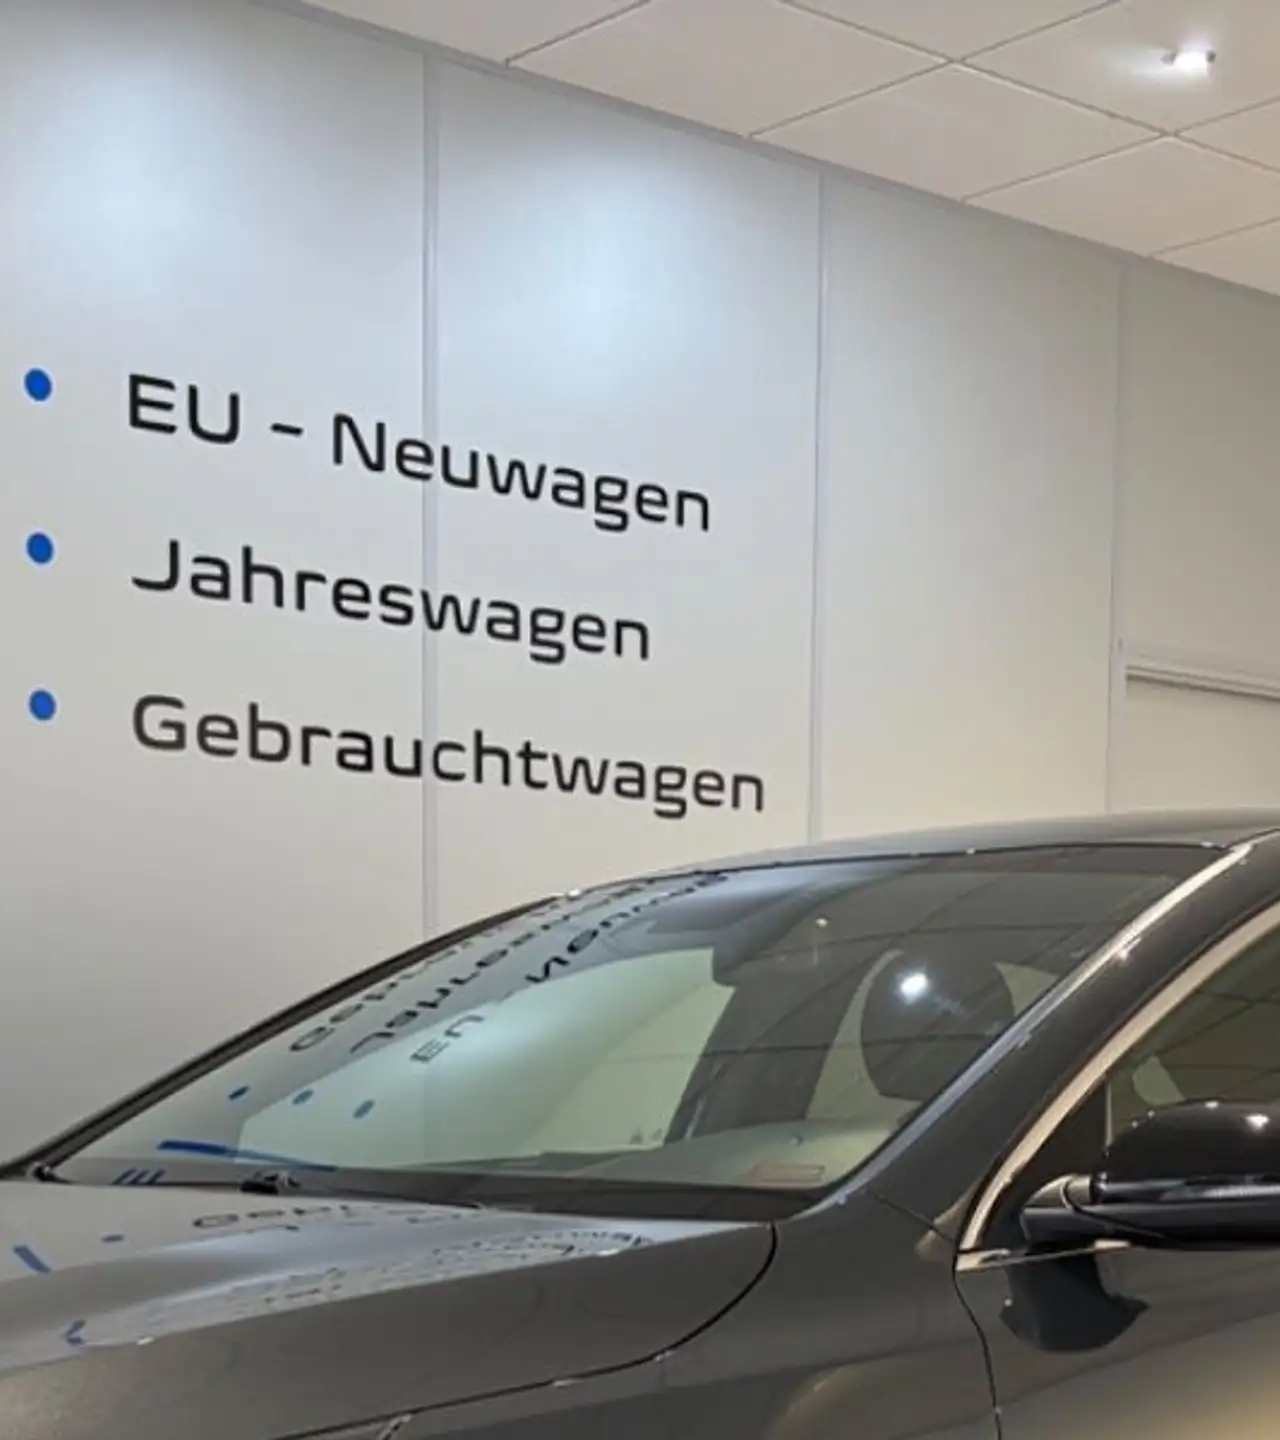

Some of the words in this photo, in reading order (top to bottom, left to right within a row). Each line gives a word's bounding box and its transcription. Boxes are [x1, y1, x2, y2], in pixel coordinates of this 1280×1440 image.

[128, 373, 240, 445] EU
[333, 413, 710, 533] Neuwagen
[131, 539, 651, 665] Jahreswagen
[133, 694, 765, 820] Gebrauchtwagen
